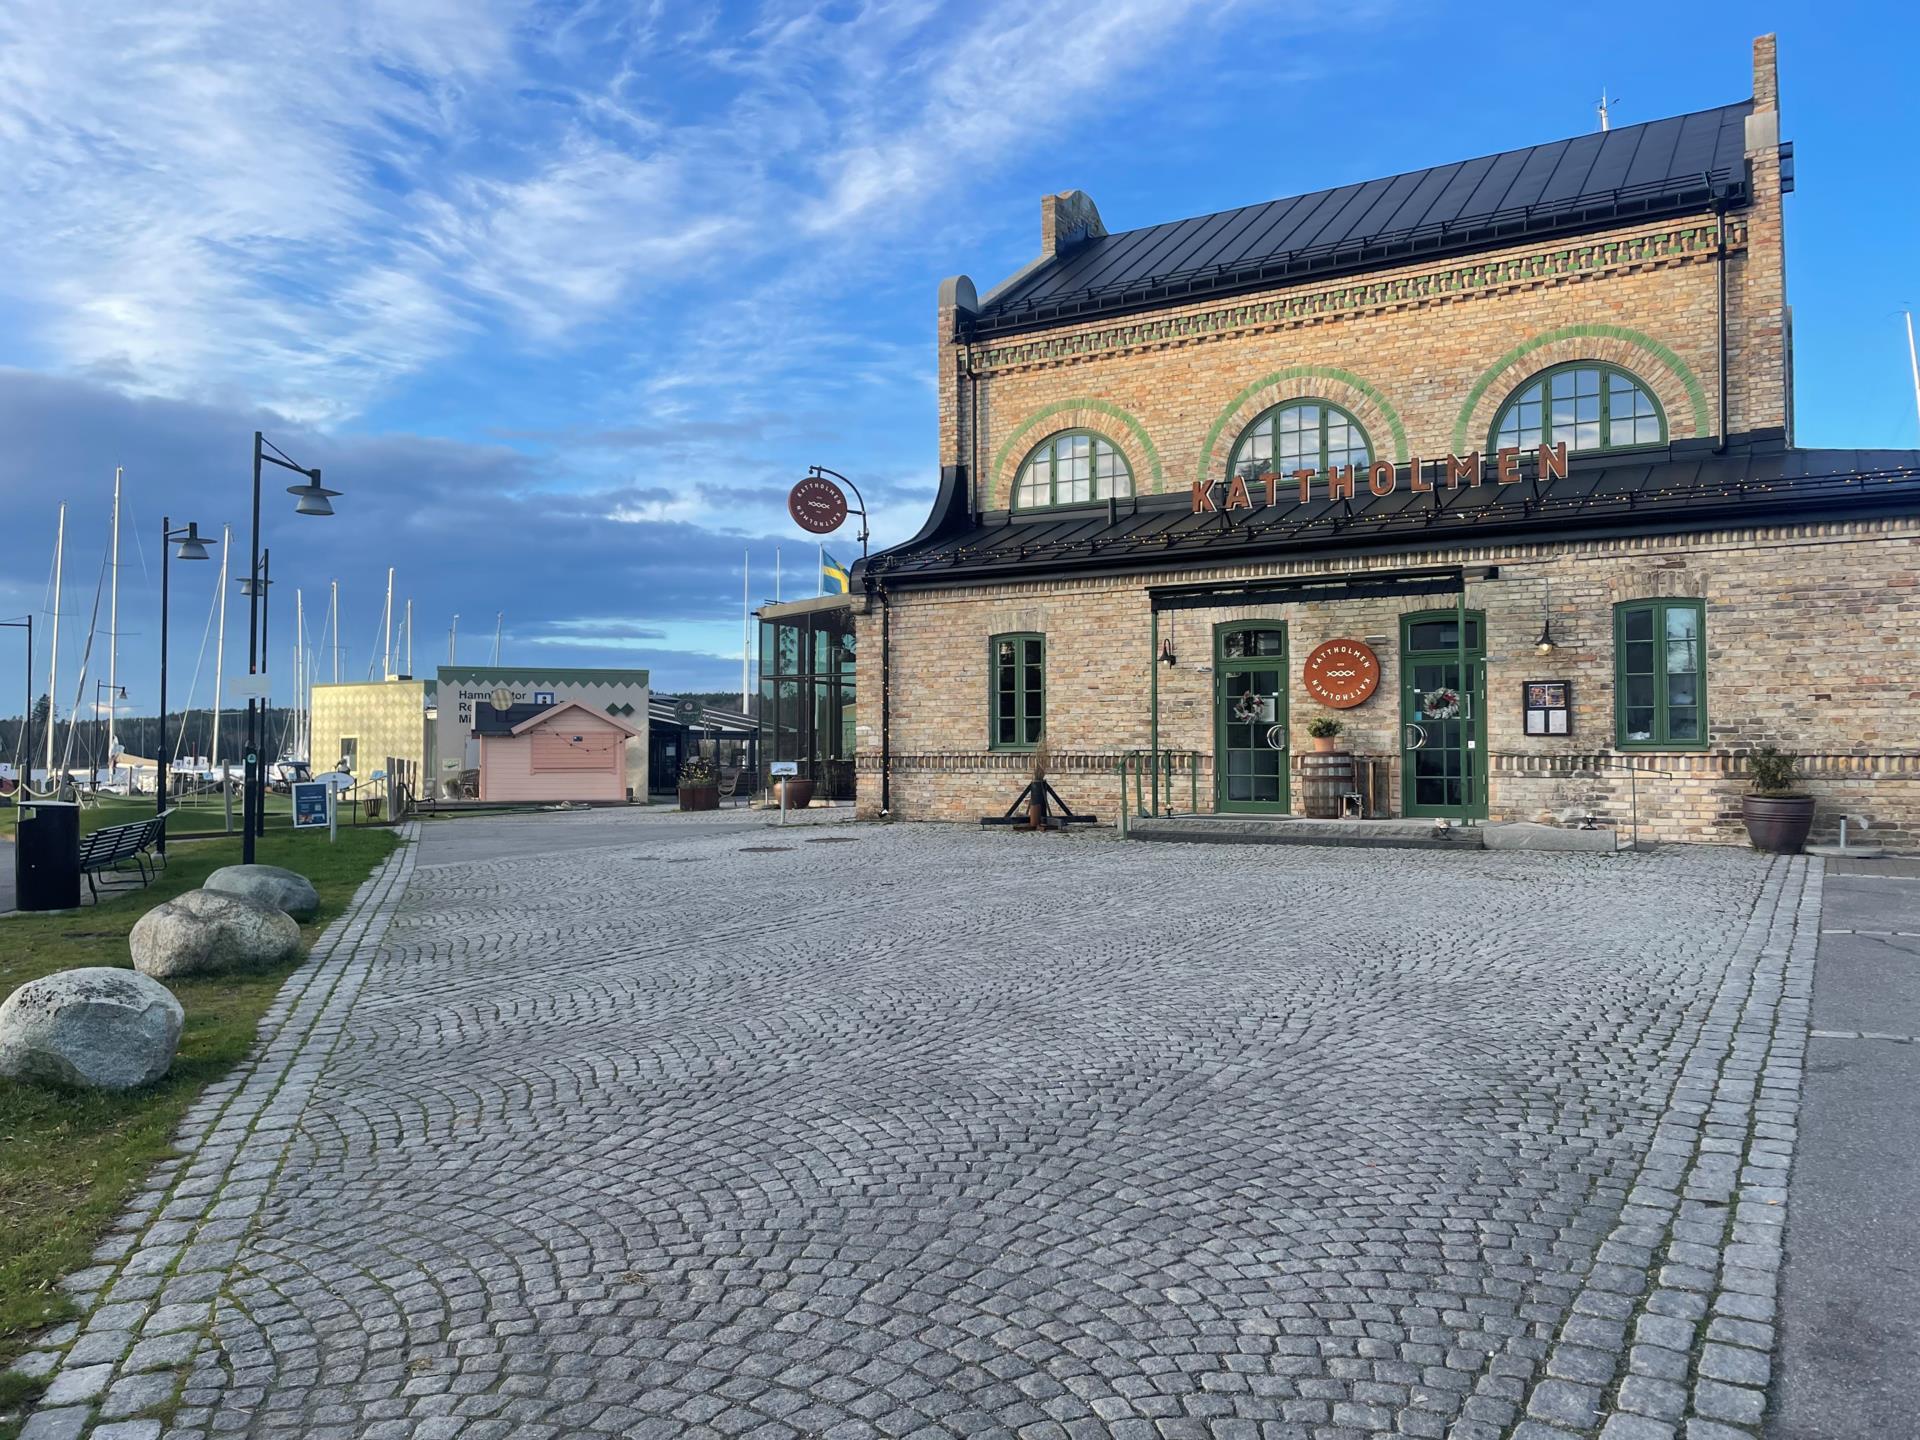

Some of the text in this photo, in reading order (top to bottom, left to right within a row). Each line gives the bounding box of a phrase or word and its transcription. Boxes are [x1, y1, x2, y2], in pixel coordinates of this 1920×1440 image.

[1191, 441, 1568, 514] KATTHOLMEN
[797, 482, 842, 505] KATTHOLMEN
[1311, 646, 1371, 670] KATTHOLMEN
[459, 690, 527, 700] Hamntor
[1311, 678, 1371, 701] KATTHOLMEN
